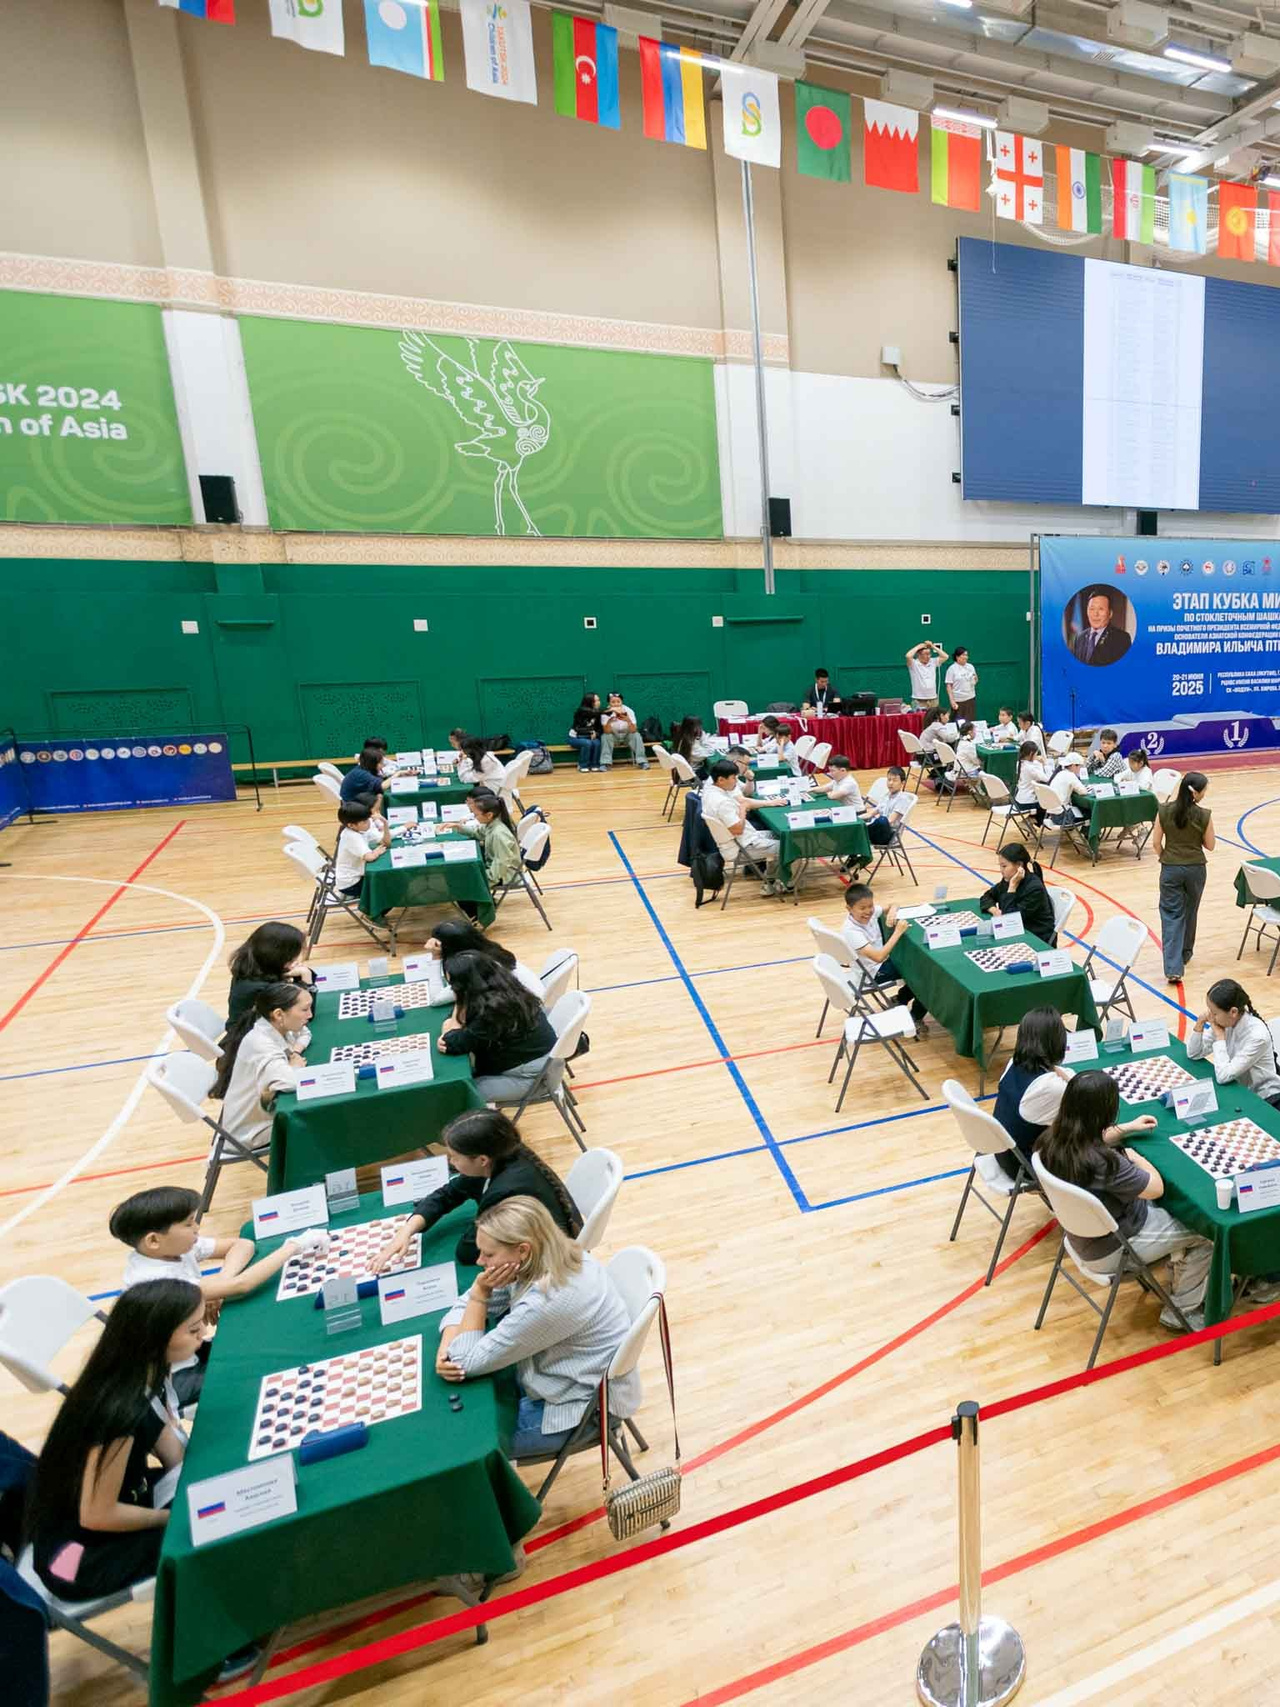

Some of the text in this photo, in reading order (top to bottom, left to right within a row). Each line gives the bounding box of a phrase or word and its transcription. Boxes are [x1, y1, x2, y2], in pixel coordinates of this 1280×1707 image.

[36, 385, 122, 411] 2024
[20, 413, 53, 436] of
[60, 416, 128, 440] Asia
[1173, 592, 1210, 611] ЭТАП
[1212, 592, 1259, 610] КУБКА
[1184, 613, 1195, 622] ПО
[1195, 612, 1256, 622] СТОКЛЕТОЧНЫМ
[1156, 642, 1221, 656] ВЛАДИМИРА
[1223, 641, 1264, 653] ИЛЬИЧА
[1172, 680, 1204, 696] 2025
[1231, 721, 1241, 741] 1
[1147, 732, 1158, 749] 2
